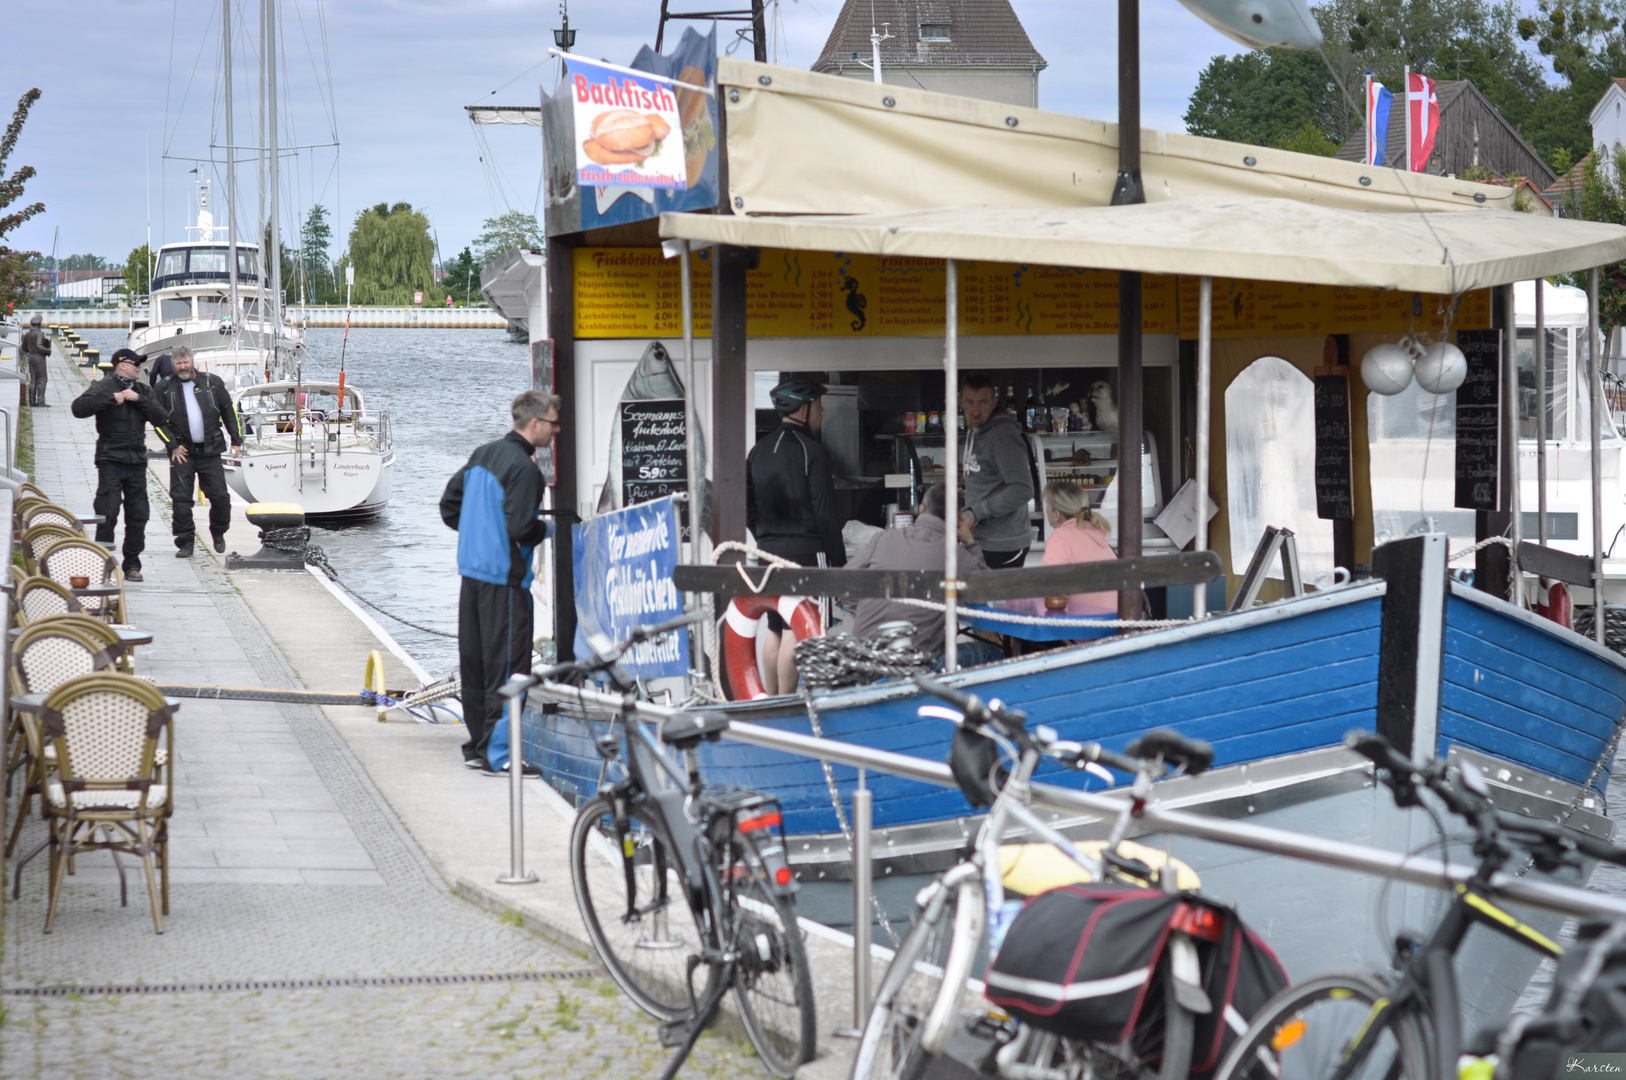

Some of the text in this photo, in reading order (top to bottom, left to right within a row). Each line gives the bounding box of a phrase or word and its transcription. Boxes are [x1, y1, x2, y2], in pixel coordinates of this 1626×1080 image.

[573, 73, 675, 112] Backfisch
[580, 167, 614, 183] Frisch
[592, 251, 679, 269] Fischbrötchen
[578, 271, 604, 280] Sherry
[879, 276, 922, 285] Matjessalat
[578, 281, 640, 290] Matjesbrötchen
[578, 291, 646, 299] Bismarkbrötchen
[770, 291, 805, 299] Brötchen
[578, 302, 650, 310] Rollmopsbrötchen
[768, 301, 804, 309] Brötchen
[578, 312, 637, 320] Lachsbrötchen
[578, 322, 648, 330] Krabbenbrötchen
[643, 454, 683, 467] Brötchen
[333, 463, 371, 471] Lauterbach
